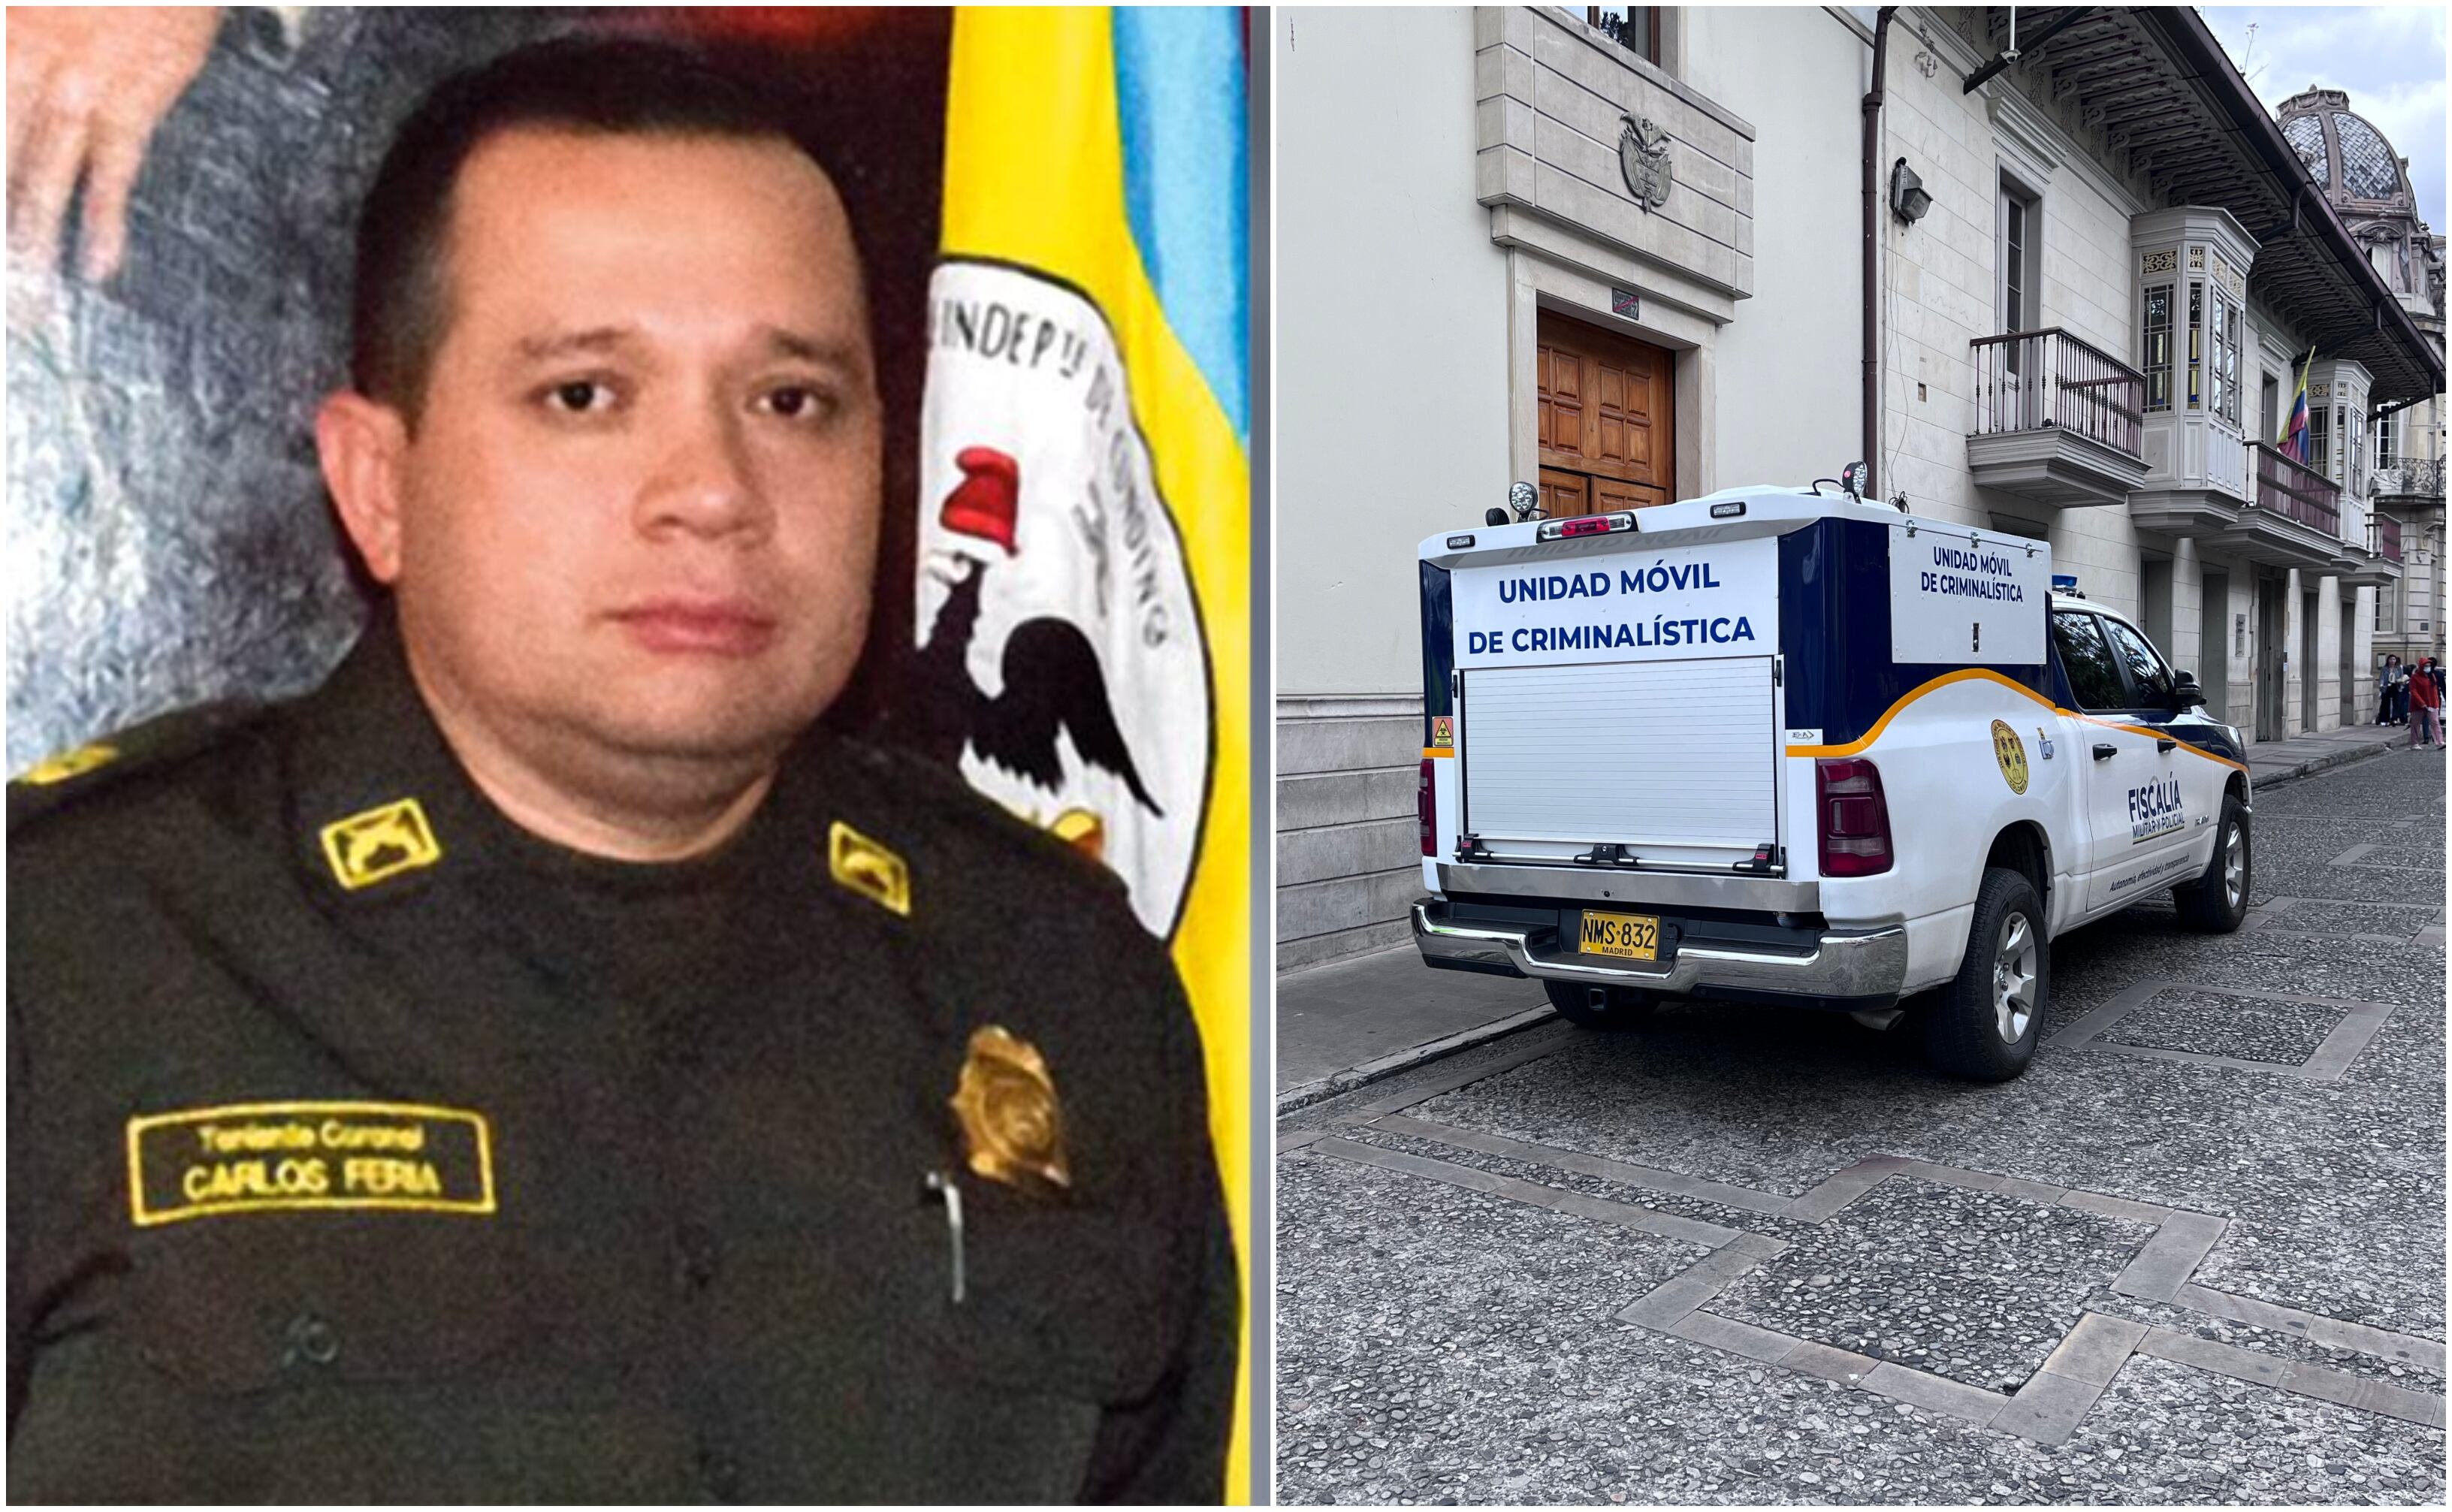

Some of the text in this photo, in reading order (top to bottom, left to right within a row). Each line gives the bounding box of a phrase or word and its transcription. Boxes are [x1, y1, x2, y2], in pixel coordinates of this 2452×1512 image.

[1934, 546, 2013, 577] UNIDAD MÓVIL
[1499, 559, 1720, 603] UNIDAD MÓVIL
[1921, 572, 2023, 602] DE CRIMINALÍSTICA
[1469, 614, 1755, 654] DE CRIMINALÍSTICA
[2128, 771, 2182, 822] FISCALÍA
[2132, 820, 2156, 839] MILITAR
[2161, 812, 2185, 830] POLICIAL
[1602, 946, 1633, 956] MADRID
[183, 1158, 442, 1200] CARLOS FERIA
